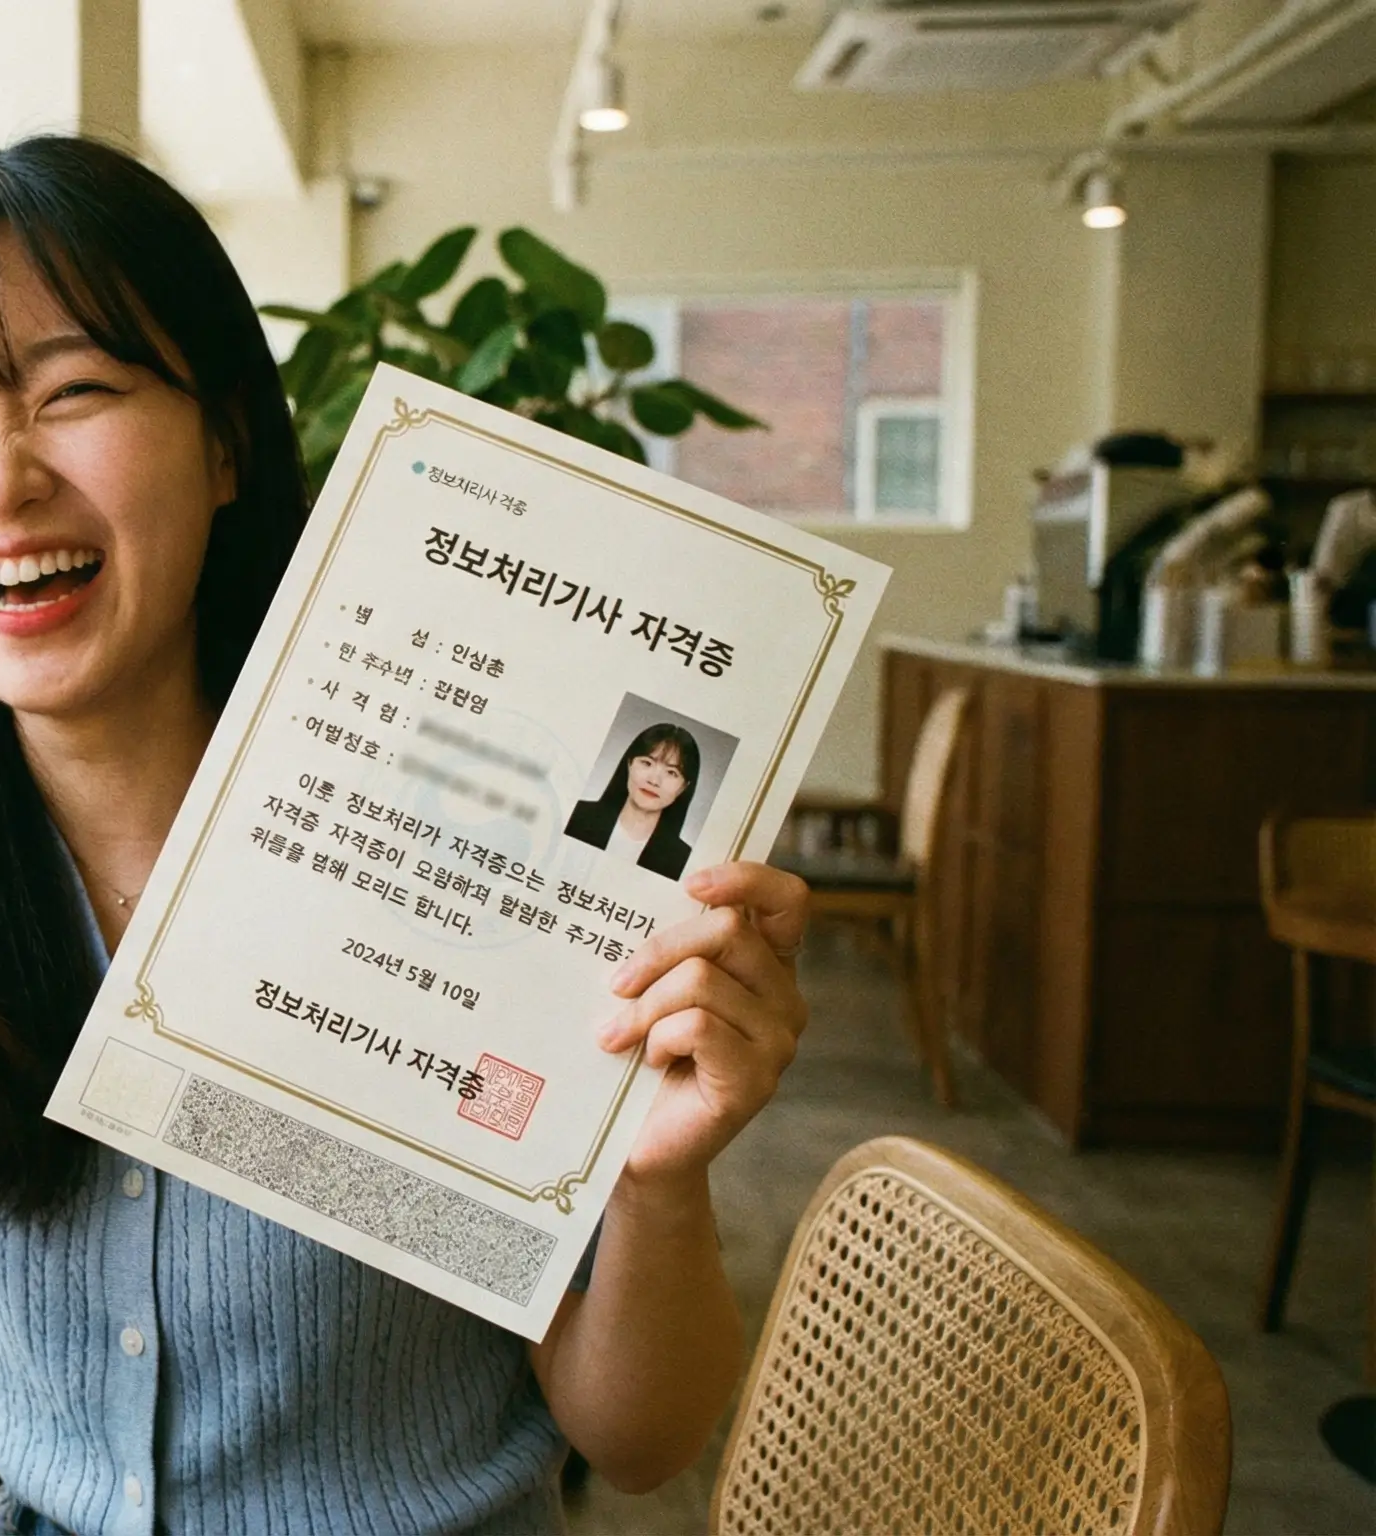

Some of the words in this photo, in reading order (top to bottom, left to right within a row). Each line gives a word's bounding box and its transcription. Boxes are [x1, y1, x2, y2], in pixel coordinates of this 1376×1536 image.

[424, 526, 623, 635] 정보처리기사
[630, 611, 735, 678] 자격증
[262, 795, 320, 833] 자격증
[328, 822, 406, 870] 자격증이
[565, 923, 635, 962] 주기증
[346, 791, 442, 848] 정보처리가
[448, 836, 545, 893] 자격증으는
[557, 880, 655, 939] 정보처리가
[351, 870, 409, 907] 모리드
[255, 979, 402, 1065] 정보처리기사
[406, 1048, 485, 1101] 자격증
[341, 937, 405, 977] 2024년
[405, 965, 437, 992] 5월
[441, 980, 481, 1011] 10일
